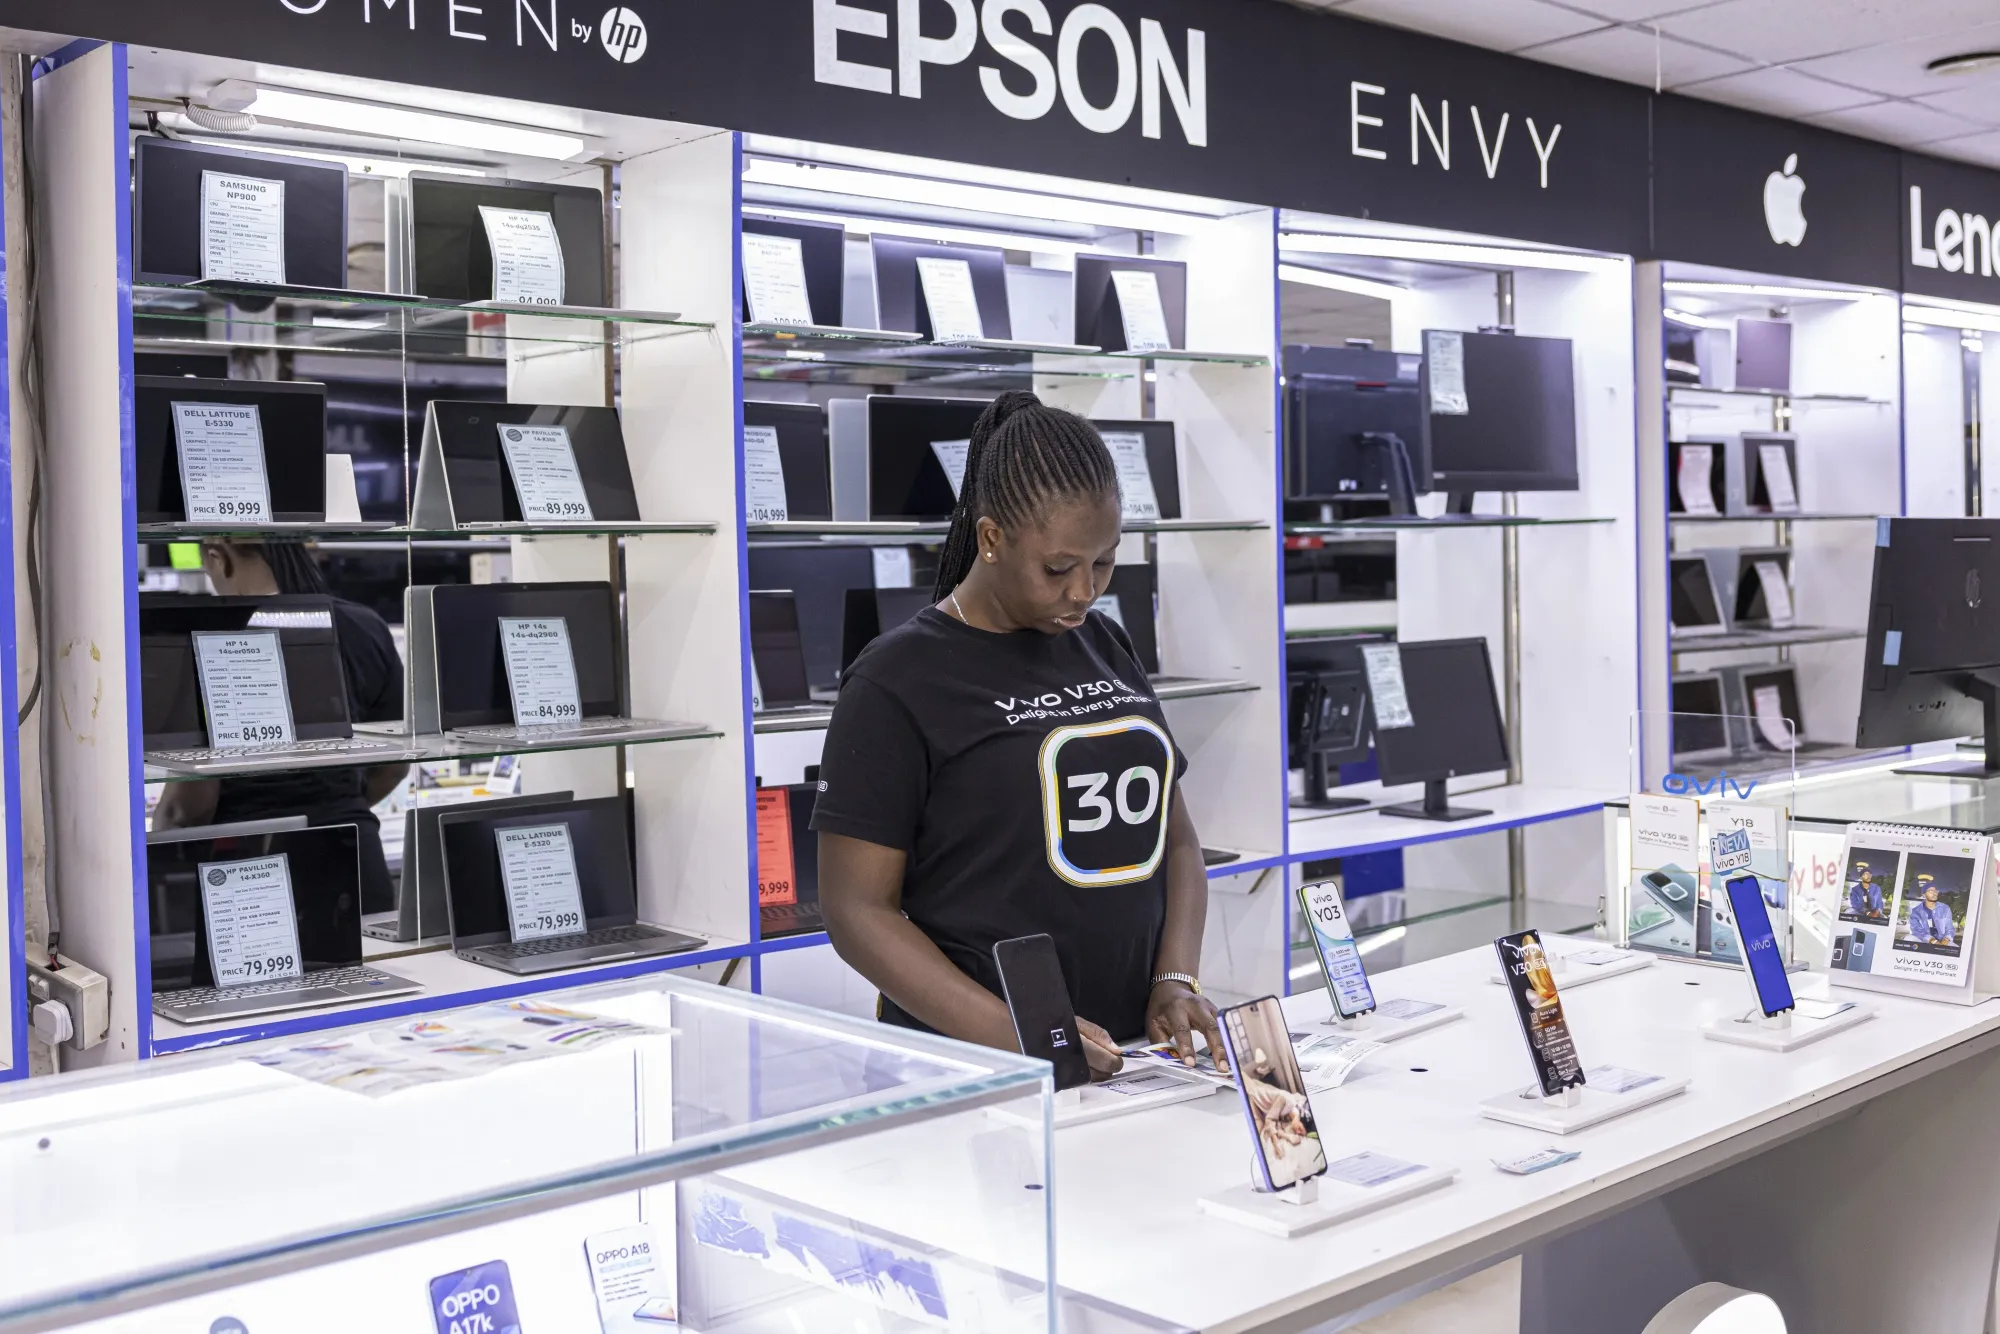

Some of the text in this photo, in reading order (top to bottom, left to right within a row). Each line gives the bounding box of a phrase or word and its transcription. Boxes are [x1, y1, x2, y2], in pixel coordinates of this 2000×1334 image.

[572, 19, 592, 43] by
[602, 7, 646, 63] hp
[814, 0, 1207, 147] EPSON
[1350, 81, 1561, 189] ENVY
[220, 181, 266, 193] SAMSUNG
[227, 192, 256, 201] NP900
[209, 411, 251, 419] LATITUDE
[219, 502, 260, 516] 89,999
[546, 502, 585, 515] 89,999
[753, 509, 785, 521] 104,999
[1063, 680, 1114, 700] V30
[539, 704, 576, 718] 84,999
[1006, 709, 1057, 725] Delight
[1057, 709, 1072, 717] in
[1071, 699, 1114, 716] Every
[243, 725, 283, 742] 84,999
[1067, 765, 1160, 832] 30
[1731, 817, 1754, 828] Y18
[506, 831, 563, 842] DELL LATIDUE
[1638, 829, 1659, 837] vivo
[1661, 832, 1677, 840] V30
[524, 840, 551, 848] E-5320
[1719, 833, 1747, 855] NEW
[239, 862, 279, 873] PAVILLION
[1715, 852, 1750, 869] vivo Y18
[240, 872, 270, 881] 14-X360
[758, 882, 789, 896] 9,999
[1313, 894, 1332, 904] vivo
[1314, 905, 1341, 922] Y03
[519, 912, 578, 930] PRICE 79,999
[1751, 939, 1771, 951] vivo
[222, 955, 293, 976] PRICE 79,999
[1511, 962, 1532, 976] V30
[1896, 957, 1920, 966] vivo
[1924, 960, 1943, 969] V30
[596, 1242, 651, 1264] OPPO A18
[441, 1284, 500, 1318] OPPO
[448, 1312, 494, 1334] A17k
